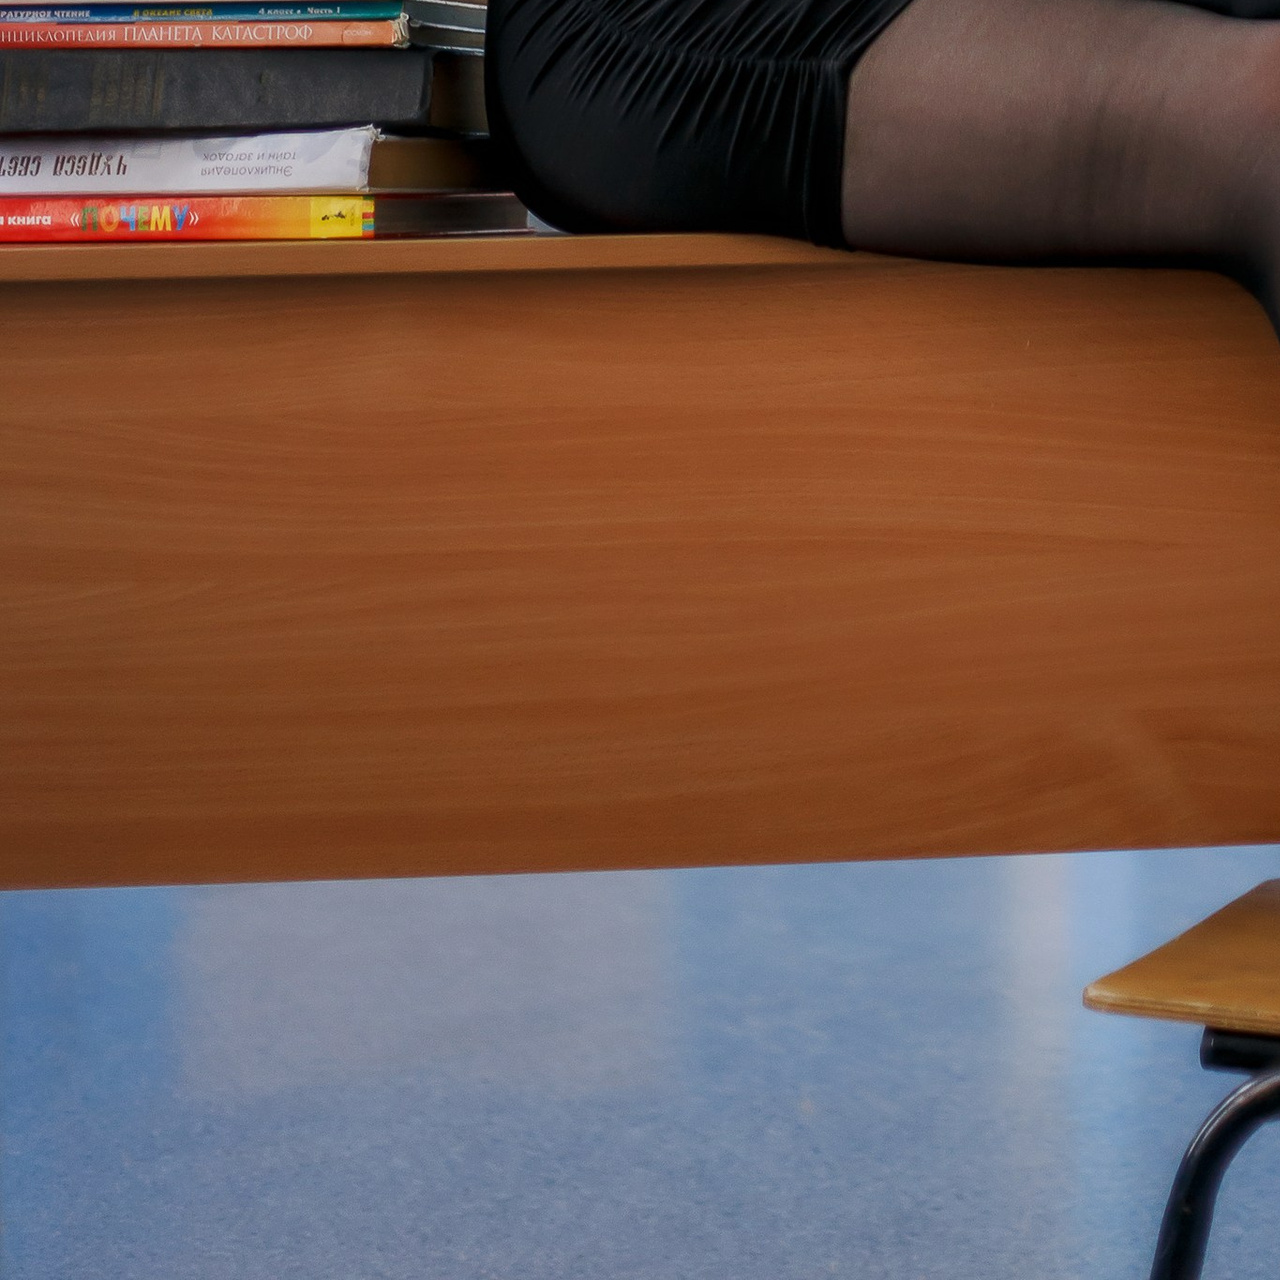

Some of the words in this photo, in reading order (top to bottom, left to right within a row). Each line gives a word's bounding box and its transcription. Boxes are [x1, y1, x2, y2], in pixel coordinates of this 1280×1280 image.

[54, 10, 91, 18] ЧТЕНИЕ
[142, 9, 182, 17] ОКЕАНЕ
[258, 7, 266, 15] 4
[307, 6, 334, 15] Часть
[124, 26, 203, 42] ПЛАНЕТА
[212, 24, 314, 41] КАТАСТРОФ
[203, 152, 254, 162] загадок
[257, 151, 266, 160] и
[268, 151, 296, 160] тайн
[52, 151, 128, 177] ЧУДЕСА
[201, 165, 293, 177] Энциклопедия
[7, 215, 52, 226] книга
[69, 205, 200, 232] «ПОЧЕМУ»
